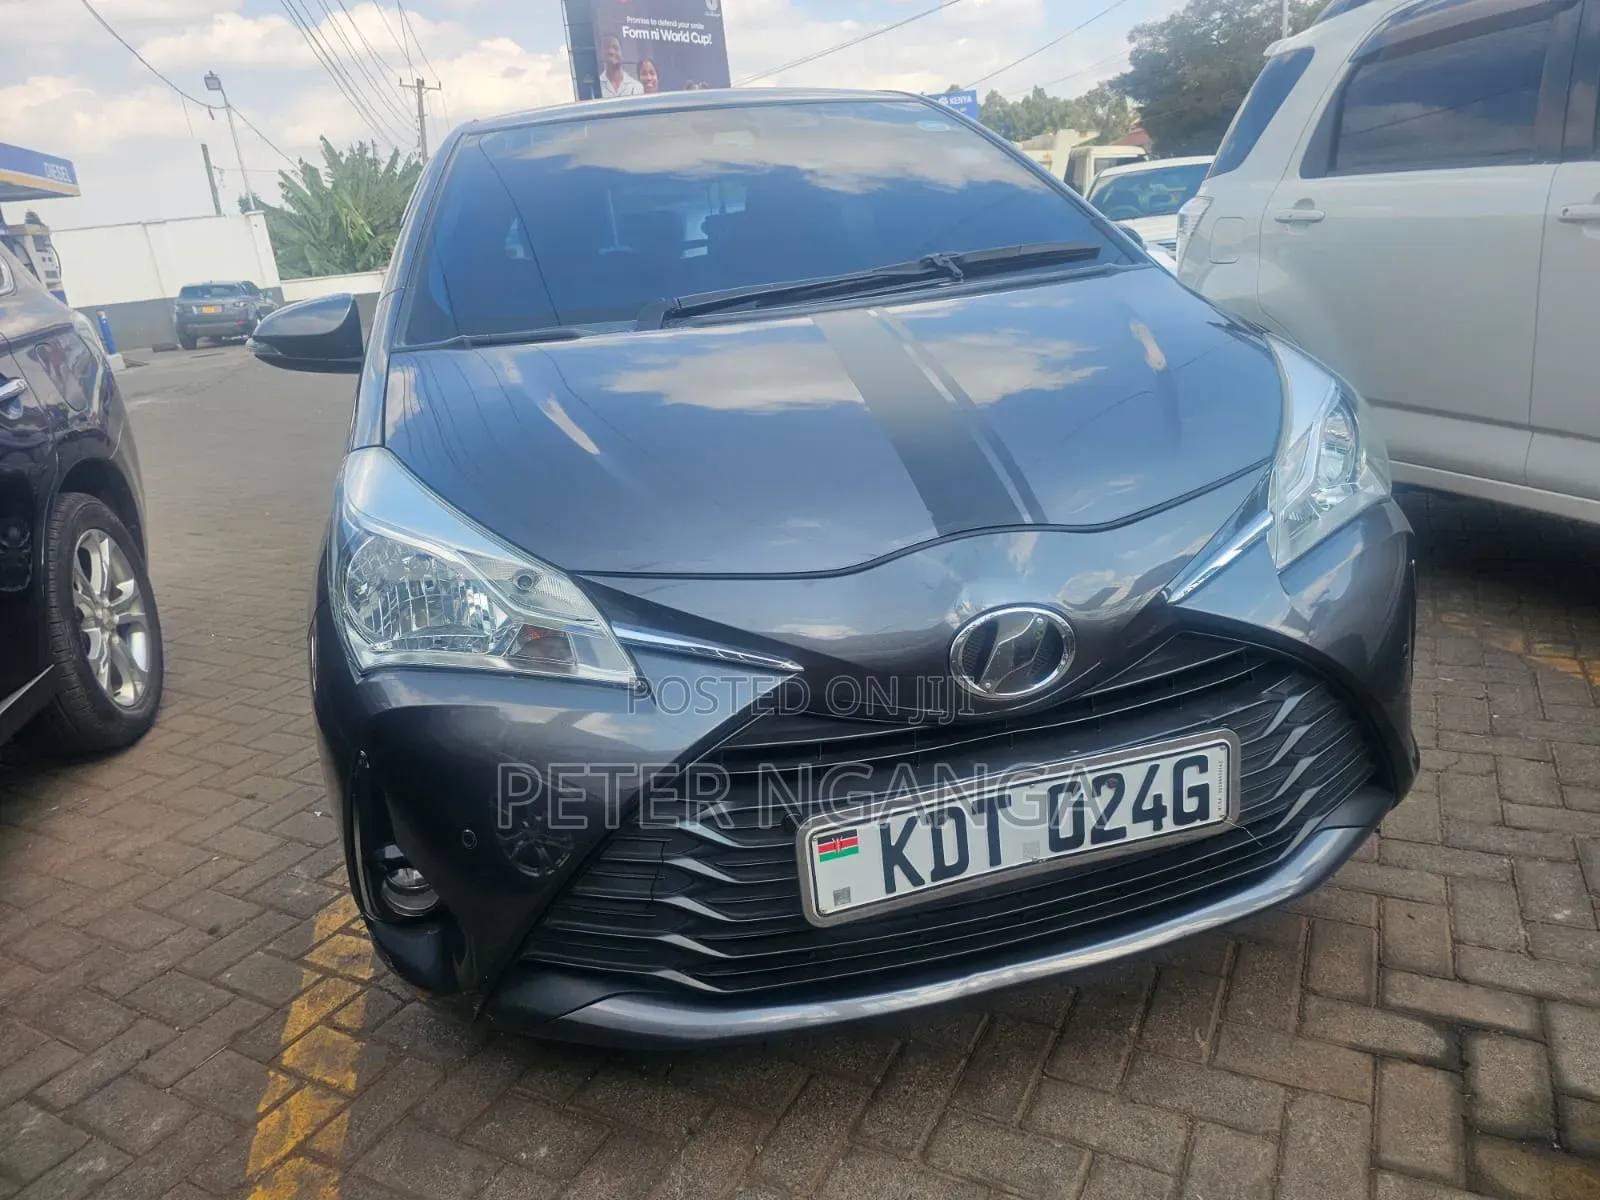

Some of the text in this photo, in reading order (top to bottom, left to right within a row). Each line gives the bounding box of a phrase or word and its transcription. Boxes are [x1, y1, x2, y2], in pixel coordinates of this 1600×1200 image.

[658, 19, 677, 27] defend
[622, 25, 713, 46] Form ni World Cup!
[949, 95, 972, 105] KENYA
[43, 161, 73, 183] DIESEL
[879, 793, 1012, 895] KDT
[1047, 755, 1210, 853] 024G
